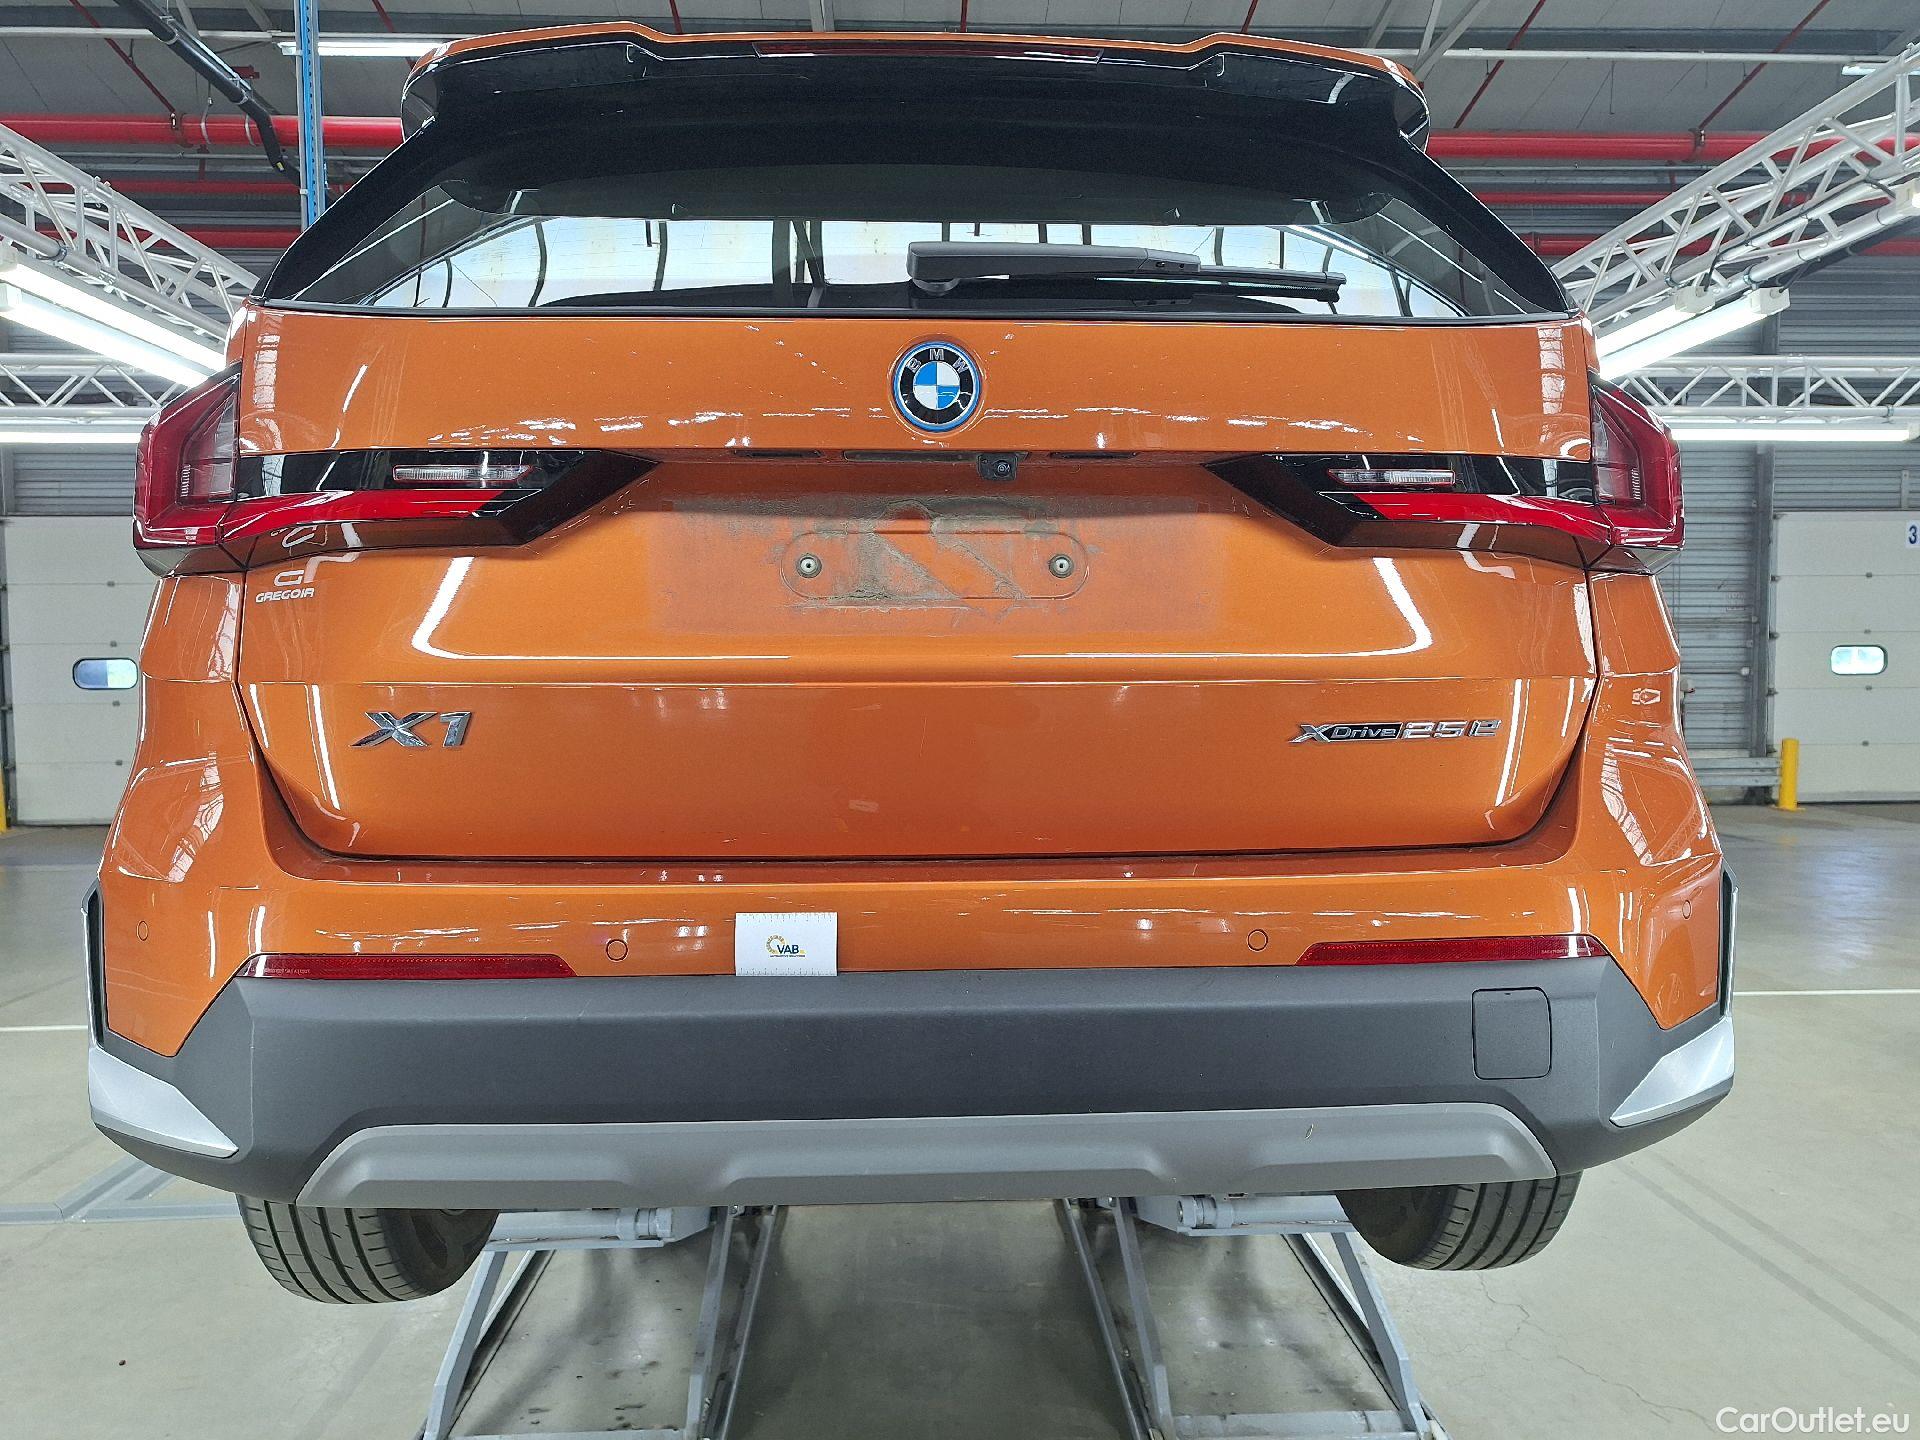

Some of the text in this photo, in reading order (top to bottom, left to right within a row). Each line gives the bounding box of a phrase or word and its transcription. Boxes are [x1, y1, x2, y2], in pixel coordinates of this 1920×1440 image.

[906, 348, 970, 374] BMW
[1908, 525, 1917, 544] 3
[255, 587, 315, 603] GREGOIR
[348, 711, 471, 747] X1
[777, 944, 799, 954] VAB
